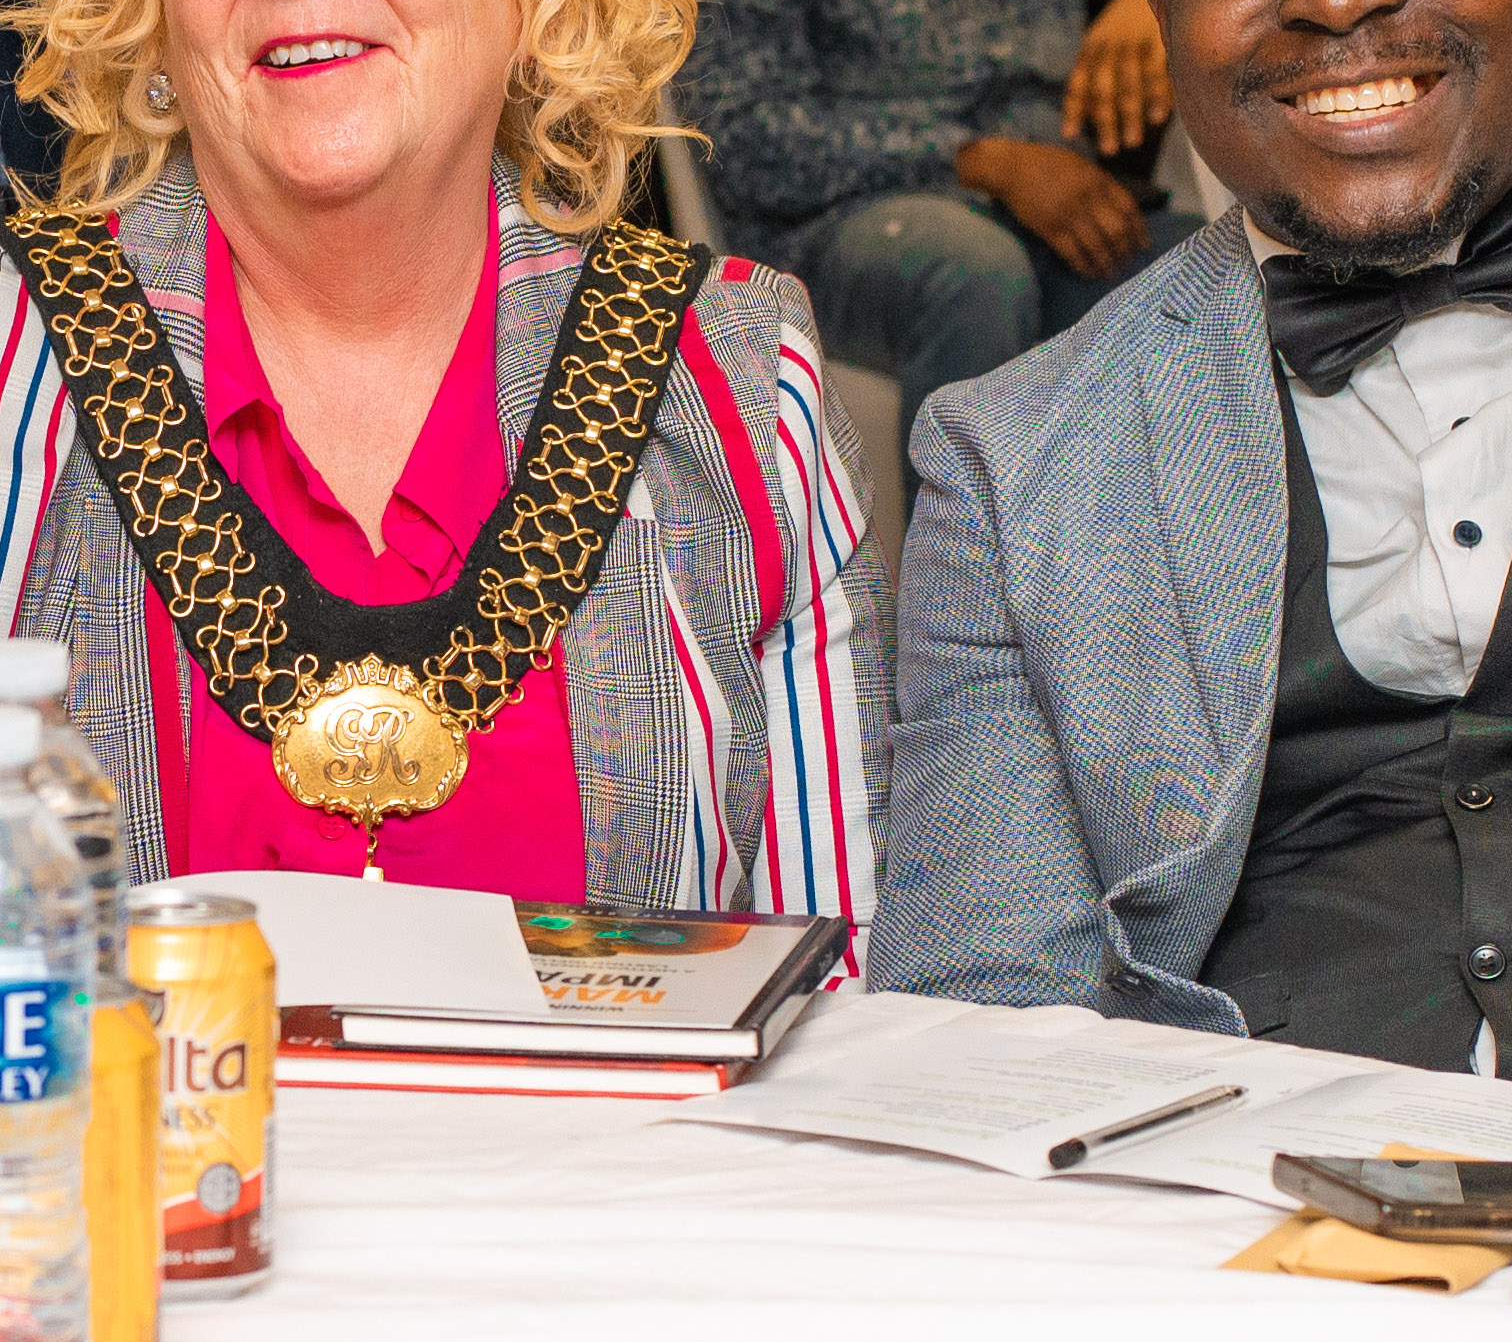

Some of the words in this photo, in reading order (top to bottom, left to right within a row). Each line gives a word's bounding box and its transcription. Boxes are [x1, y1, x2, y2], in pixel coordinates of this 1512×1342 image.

[536, 970, 662, 988] IMPA
[542, 984, 668, 1004] MAK
[549, 1003, 624, 1012] WINNIN
[167, 1036, 246, 1092] lta
